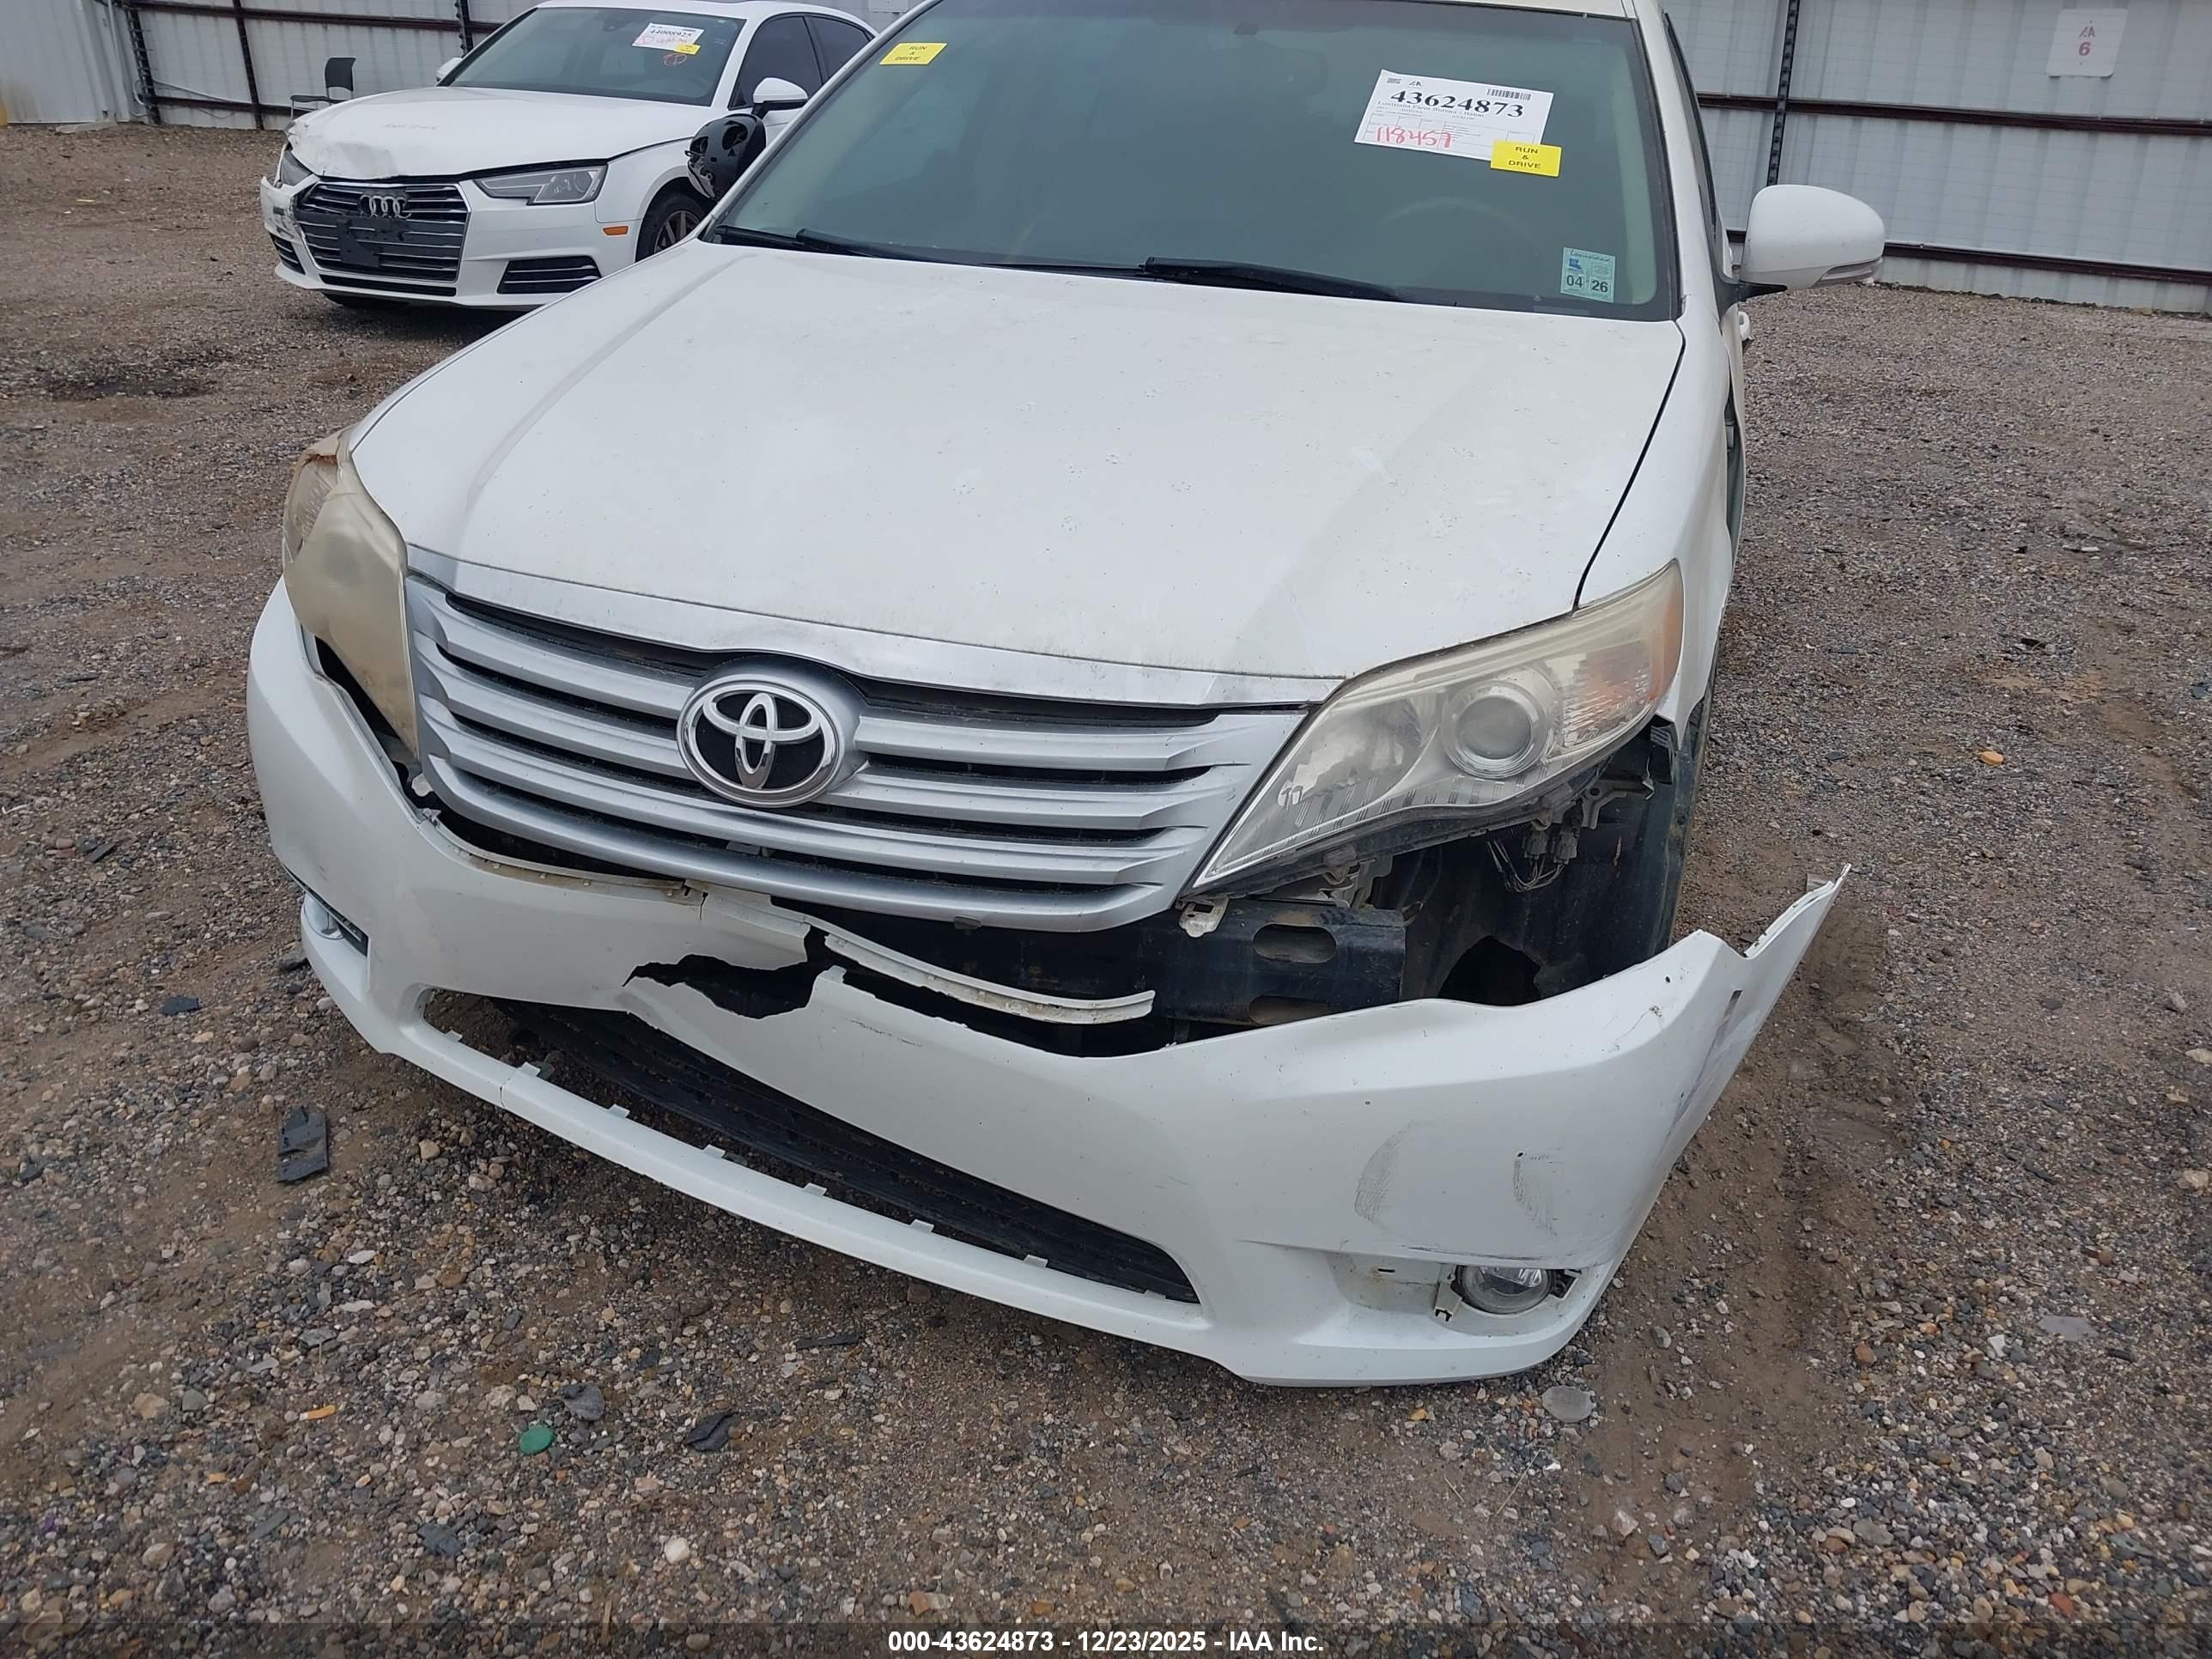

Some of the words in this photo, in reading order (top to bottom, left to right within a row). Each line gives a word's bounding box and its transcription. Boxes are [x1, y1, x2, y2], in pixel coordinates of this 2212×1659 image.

[2079, 41, 2090, 56] 6
[1389, 90, 1524, 118] 43624873
[1376, 126, 1451, 148] 118457
[1508, 160, 1542, 169] DRIVE
[1566, 275, 1583, 289] 04
[1592, 280, 1608, 293] 26
